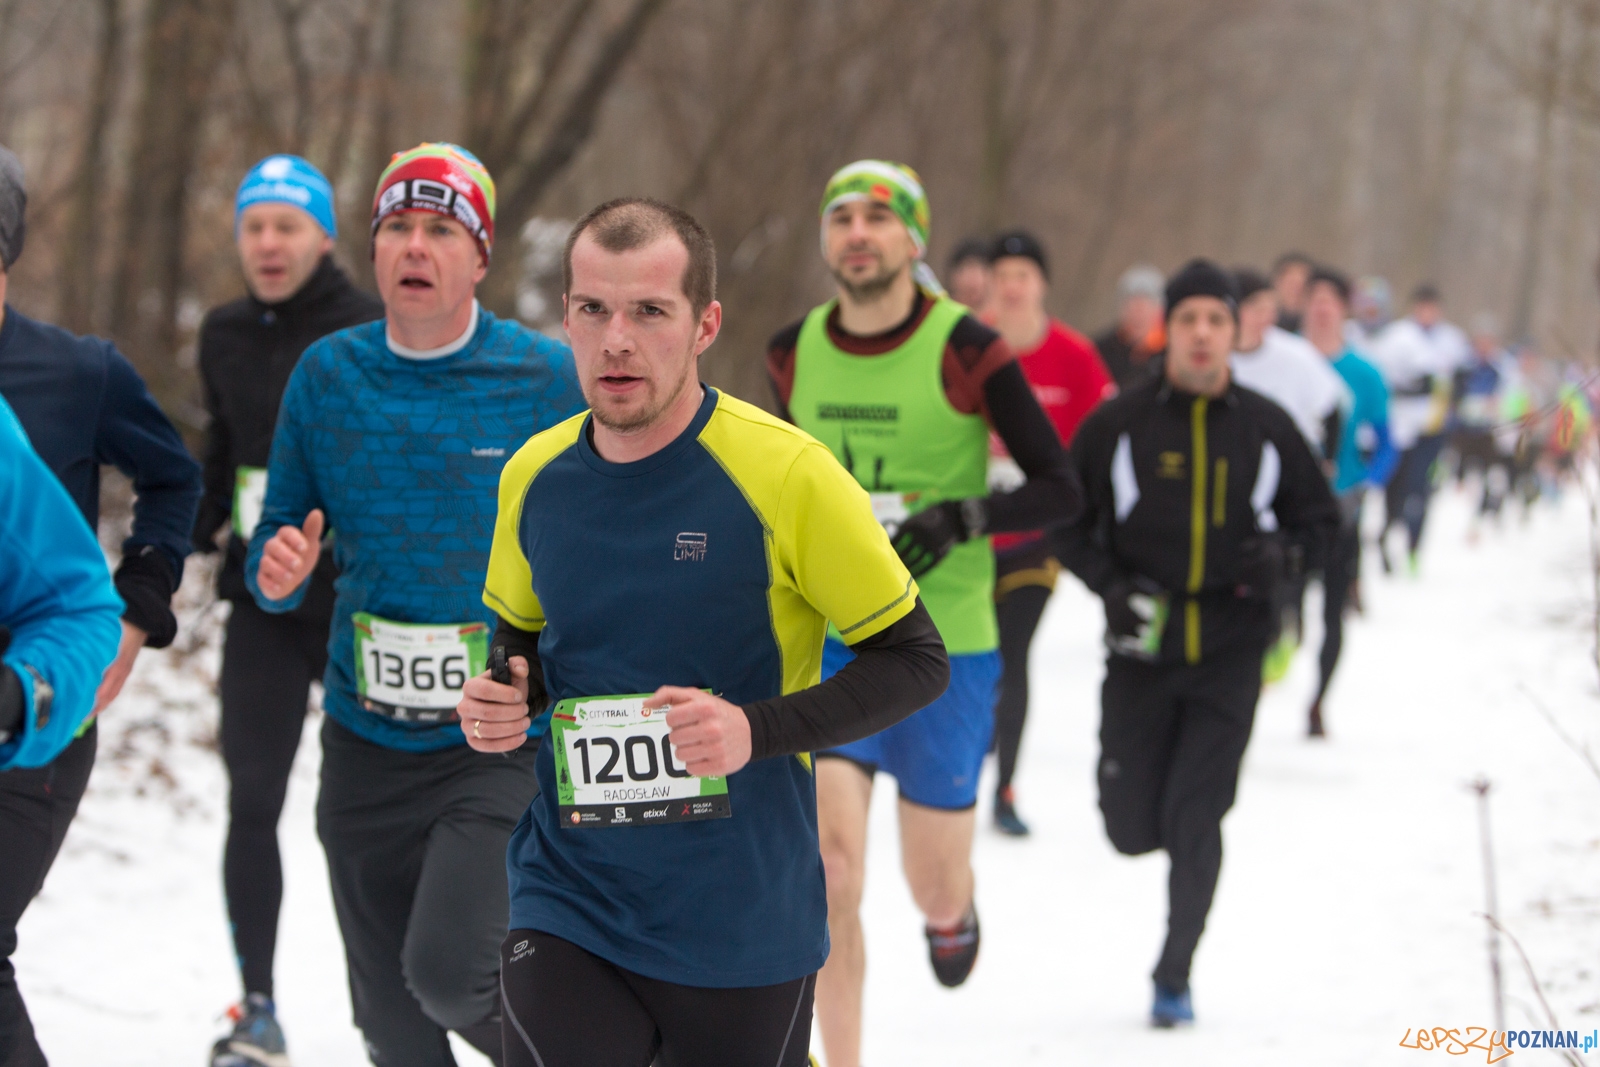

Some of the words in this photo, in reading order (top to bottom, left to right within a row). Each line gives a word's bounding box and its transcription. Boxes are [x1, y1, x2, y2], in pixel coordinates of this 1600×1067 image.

[674, 549, 707, 561] LIMIT
[370, 650, 465, 690] 1366
[603, 786, 671, 801] RADOSŁAW
